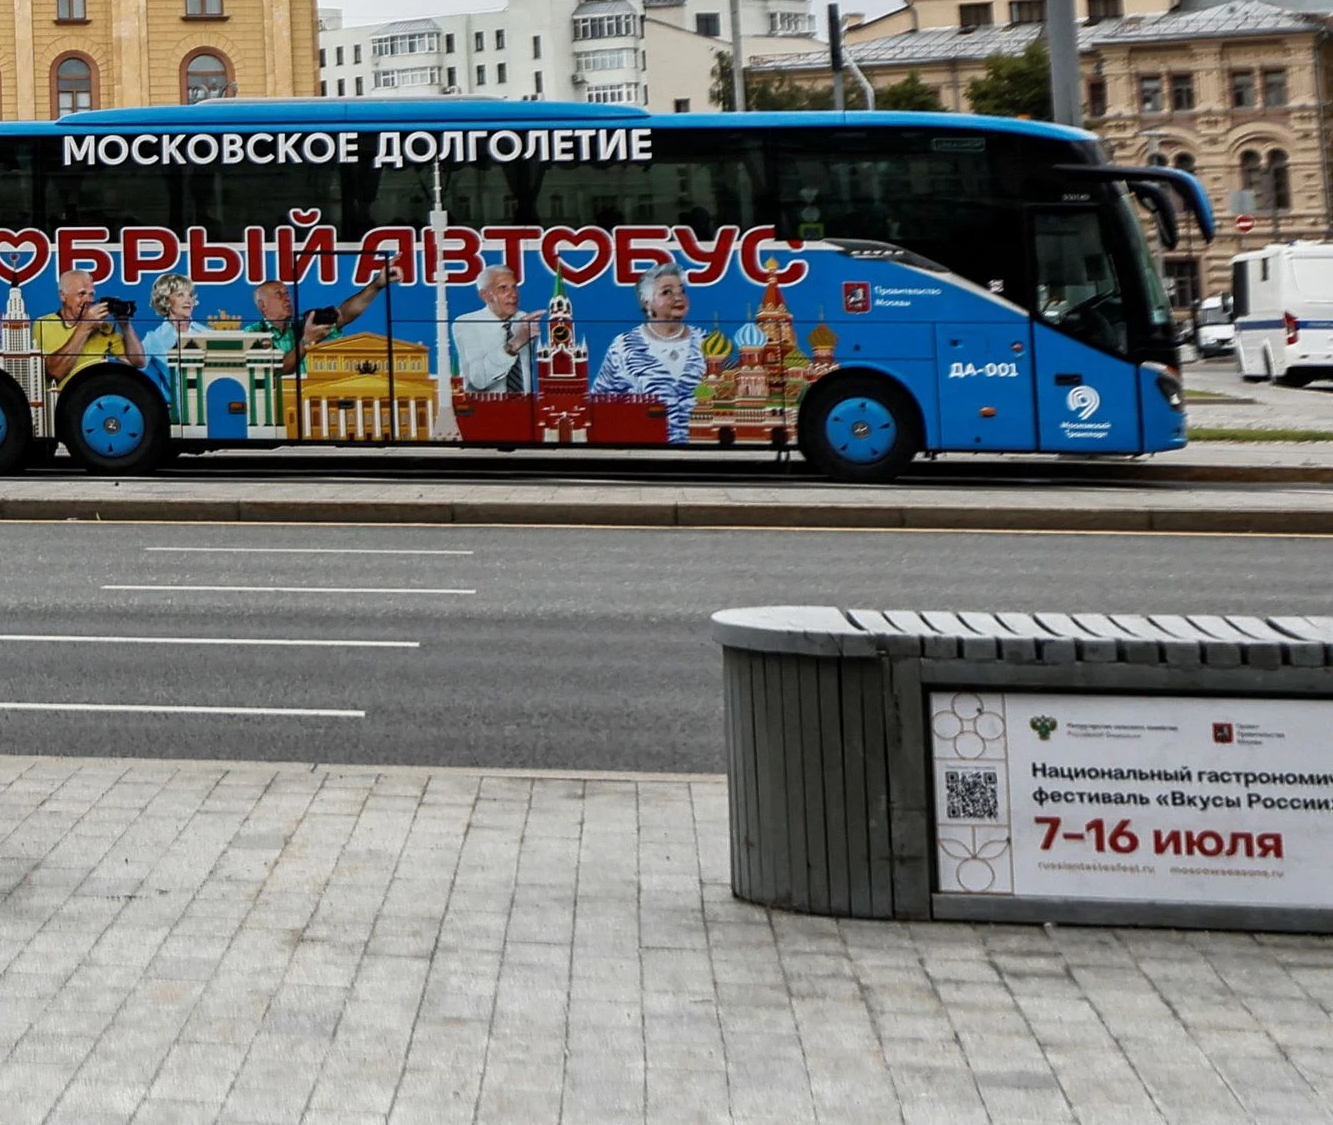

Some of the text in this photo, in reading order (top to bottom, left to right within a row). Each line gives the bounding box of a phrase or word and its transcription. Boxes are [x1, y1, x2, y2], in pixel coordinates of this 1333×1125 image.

[62, 128, 653, 169] МОСКОВСКОЕ ДОЛГОЛЕТИЕ
[352, 224, 810, 287] АВТОБУС
[948, 362, 1019, 379] ДА-001
[1032, 761, 1193, 783] Национальный
[1032, 786, 1151, 808] фестиваль
[1156, 790, 1242, 811] «Вкусы
[1153, 828, 1284, 860] июля
